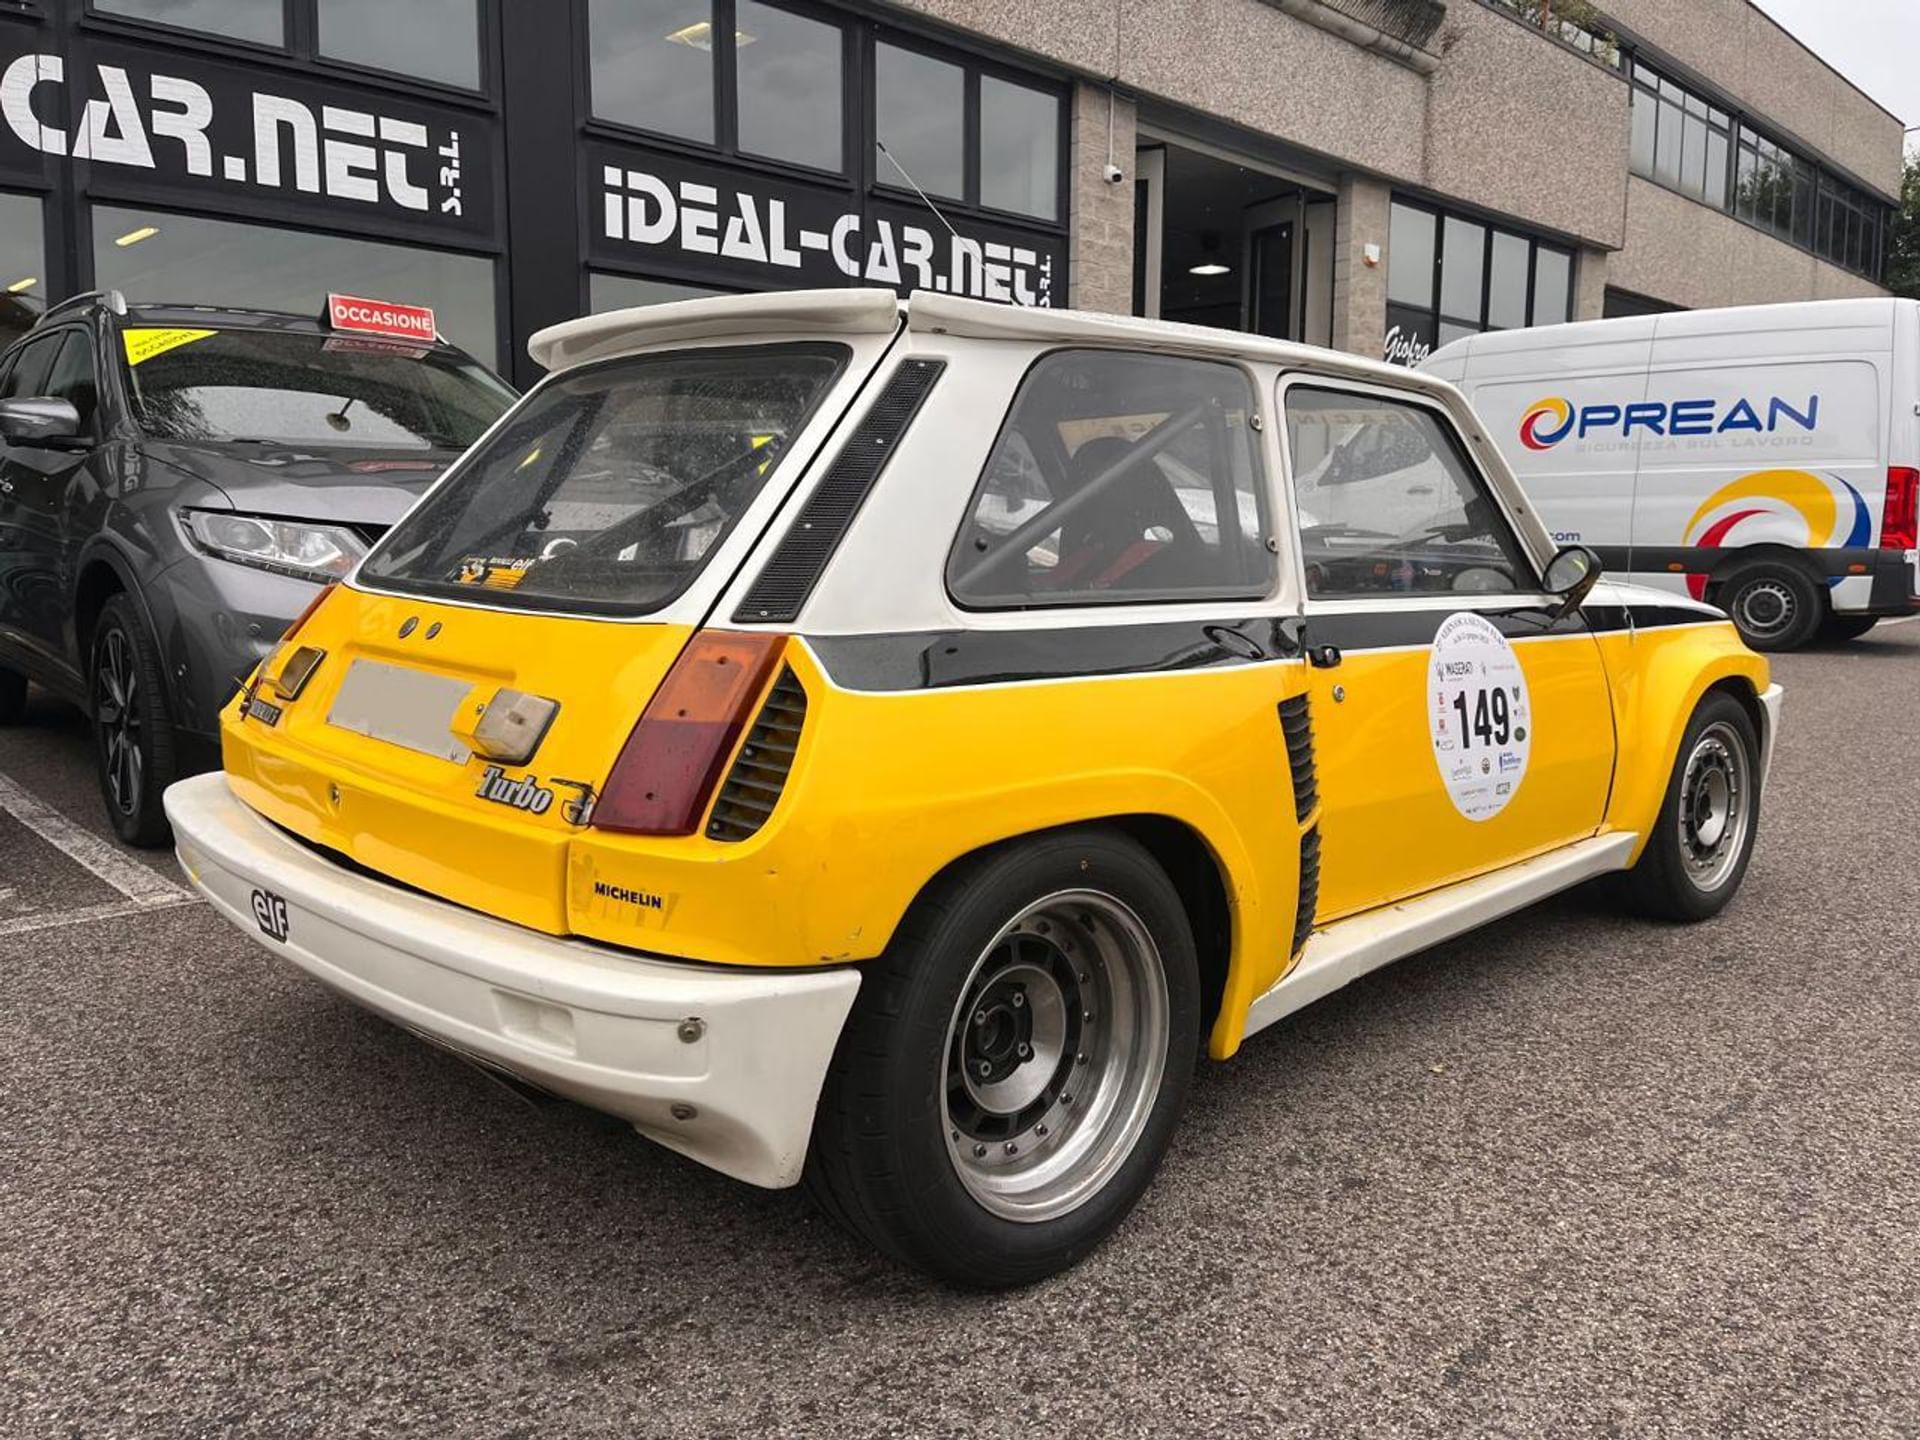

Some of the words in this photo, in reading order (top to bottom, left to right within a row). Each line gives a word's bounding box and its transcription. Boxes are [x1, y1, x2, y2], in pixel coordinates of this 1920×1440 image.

[334, 304, 432, 331] OCCASIONE
[1453, 687, 1510, 749] 149
[476, 766, 554, 815] Turbo
[252, 890, 288, 943] elf
[595, 882, 662, 909] MICHELIN
